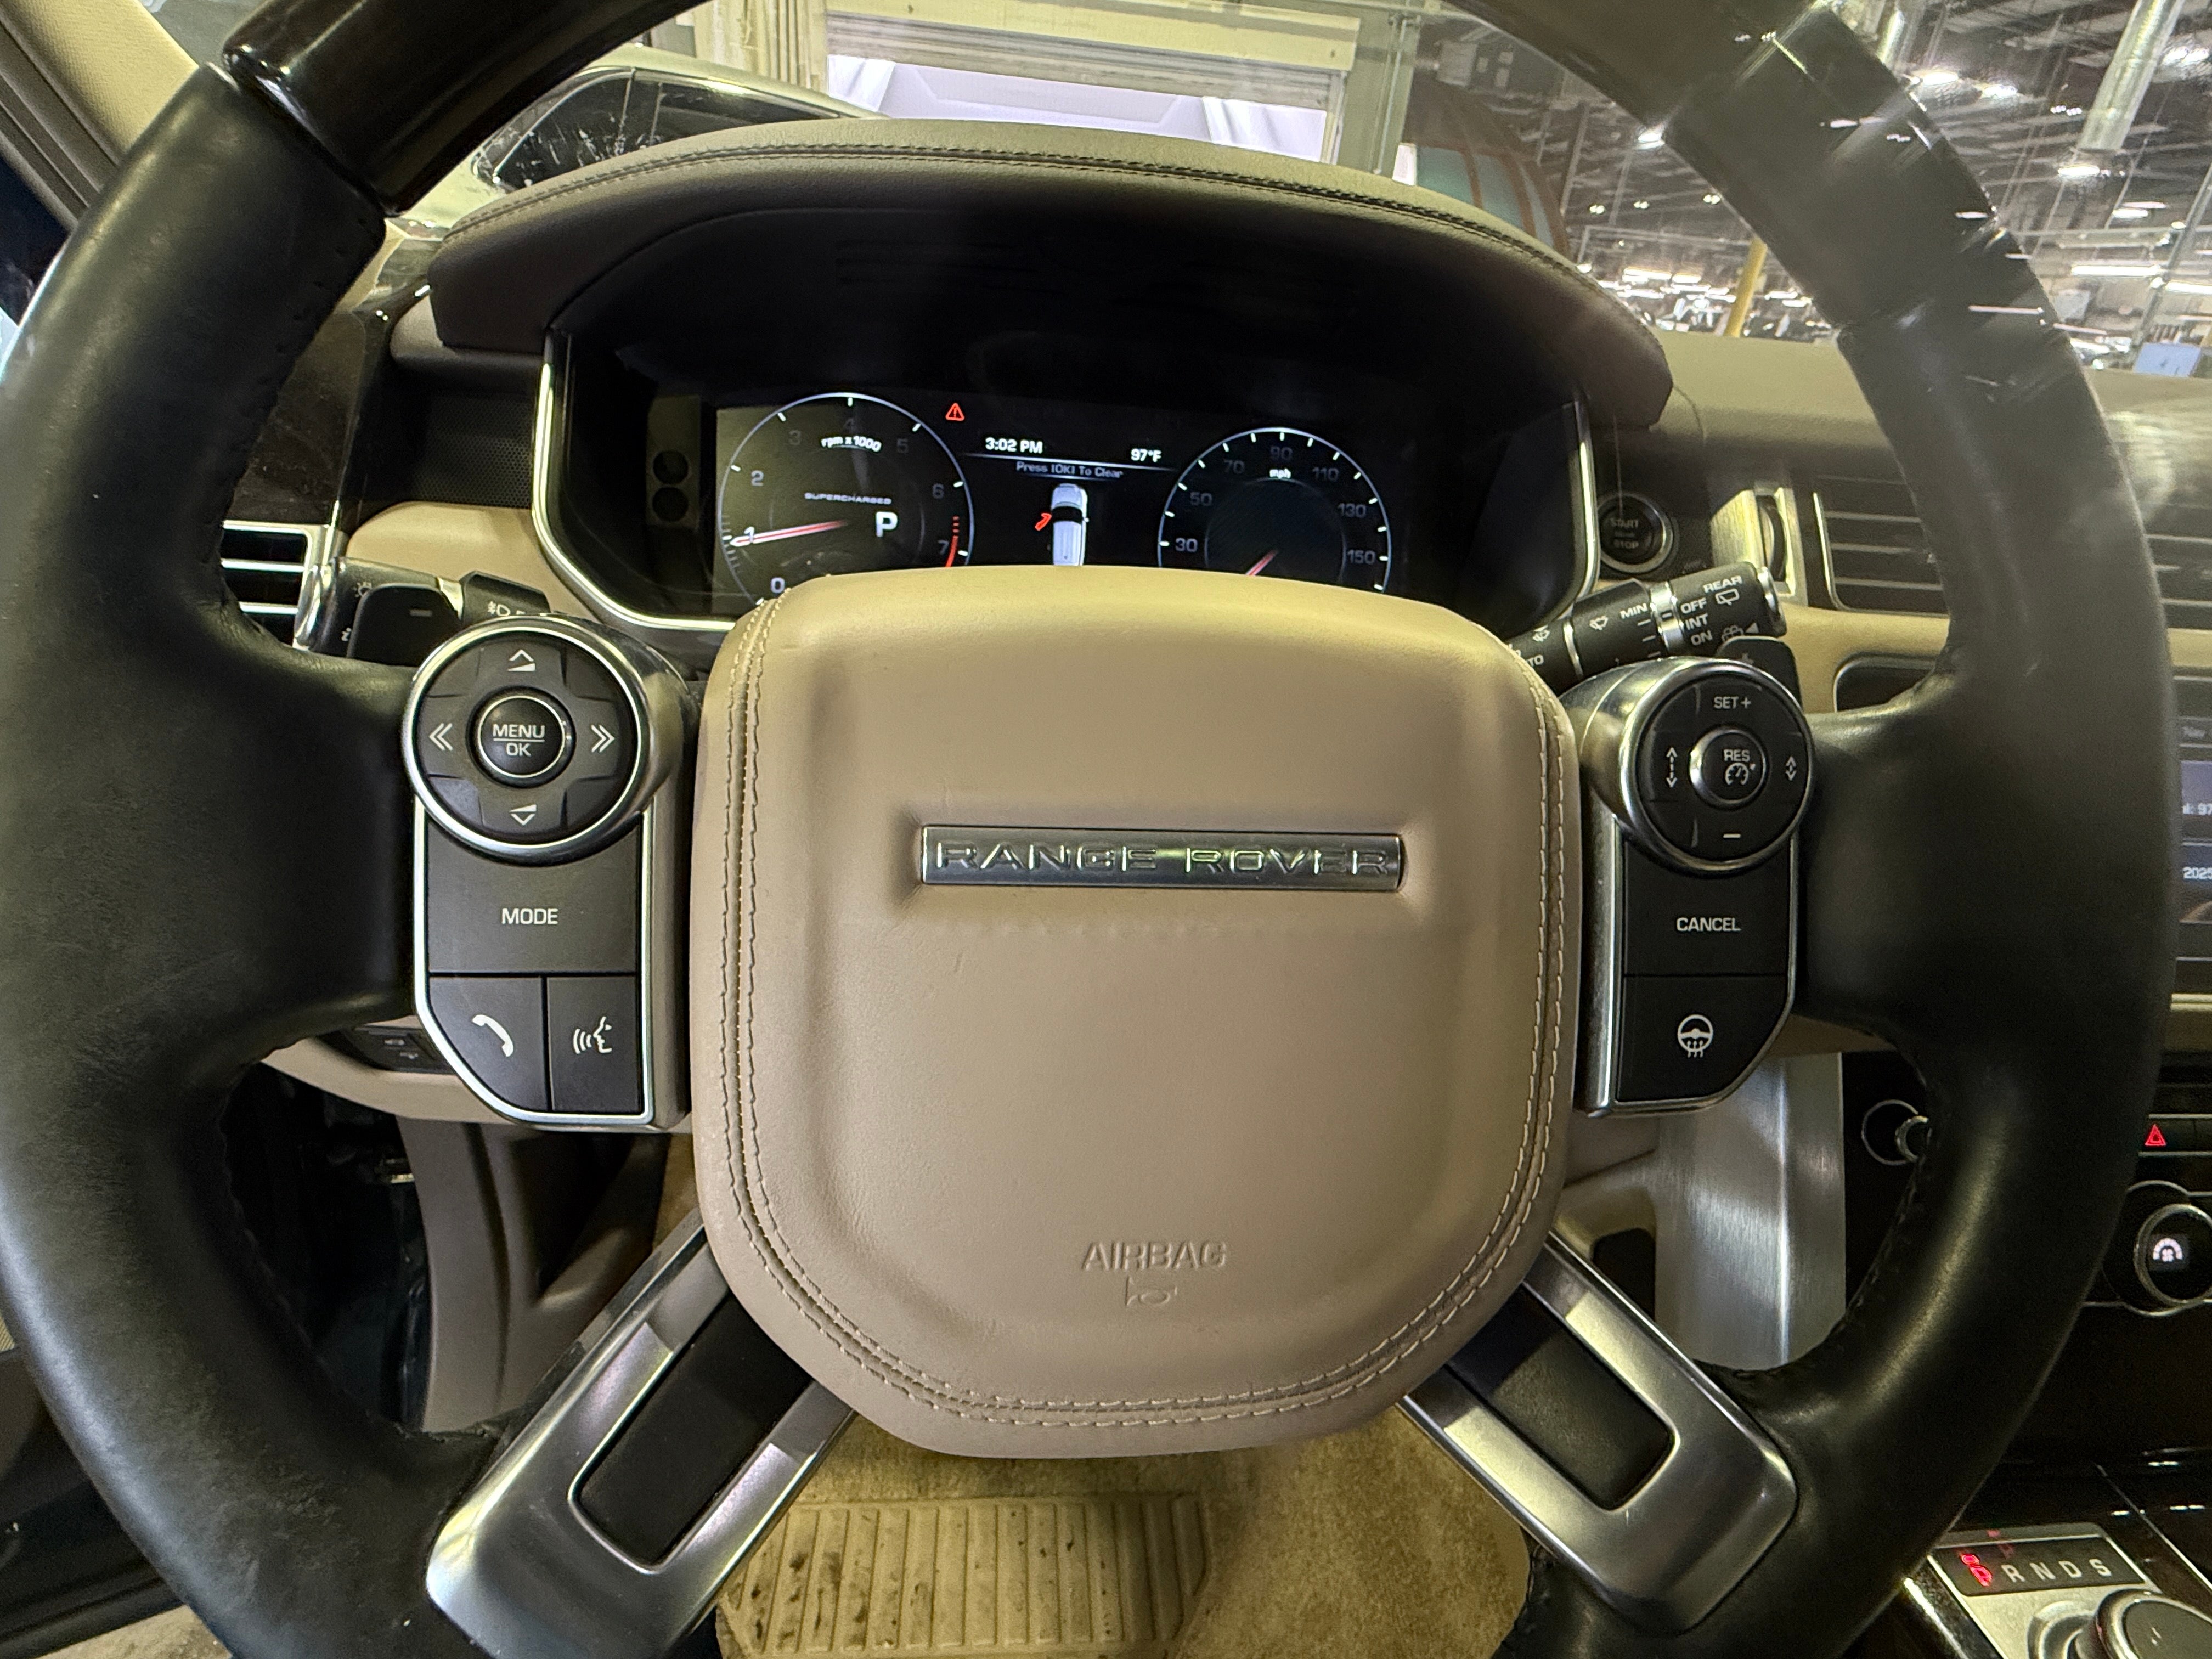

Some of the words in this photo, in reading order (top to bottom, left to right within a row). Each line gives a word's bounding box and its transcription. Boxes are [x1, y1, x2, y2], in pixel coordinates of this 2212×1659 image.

[789, 430, 800, 445] 3
[821, 436, 843, 448] rpm
[853, 435, 882, 452] 1000
[985, 437, 1017, 452] 3:02
[1020, 440, 1042, 454] PM
[898, 439, 908, 454] 5
[1131, 448, 1161, 462] 97°F
[1016, 461, 1048, 473] Press
[1079, 466, 1092, 476] To
[1094, 467, 1124, 478] Clear
[1224, 459, 1245, 473] 70
[1269, 468, 1290, 479] mph
[1313, 466, 1339, 482] 110
[751, 470, 764, 486] 2
[804, 492, 892, 505] SUPERCHARGED
[933, 484, 944, 498] 6
[1190, 492, 1212, 506] 50
[1338, 503, 1366, 518] 130
[876, 511, 898, 538] P
[744, 526, 755, 543] 1
[938, 540, 950, 556] 7
[1175, 537, 1198, 552] 30
[1346, 549, 1375, 565] 150
[770, 577, 785, 594] 0
[1703, 575, 1743, 594] REAR
[1620, 602, 1648, 619] MIN
[1680, 598, 1707, 615] OFF
[1685, 614, 1709, 630] INT
[1690, 630, 1713, 646] ON
[1713, 697, 1739, 709] SET
[492, 724, 545, 739] MENU
[506, 743, 531, 757] OK
[1723, 749, 1751, 761] RES
[936, 842, 1158, 871] RANGE
[1185, 846, 1389, 877] ROVER
[501, 909, 558, 925] MODE
[1676, 917, 1741, 933] CANCEL
[1081, 1241, 1227, 1272] AIRBAG
[2001, 1564, 2024, 1583] R
[2032, 1563, 2056, 1581] N
[2059, 1560, 2083, 1578] D
[2089, 1558, 2111, 1577] S
